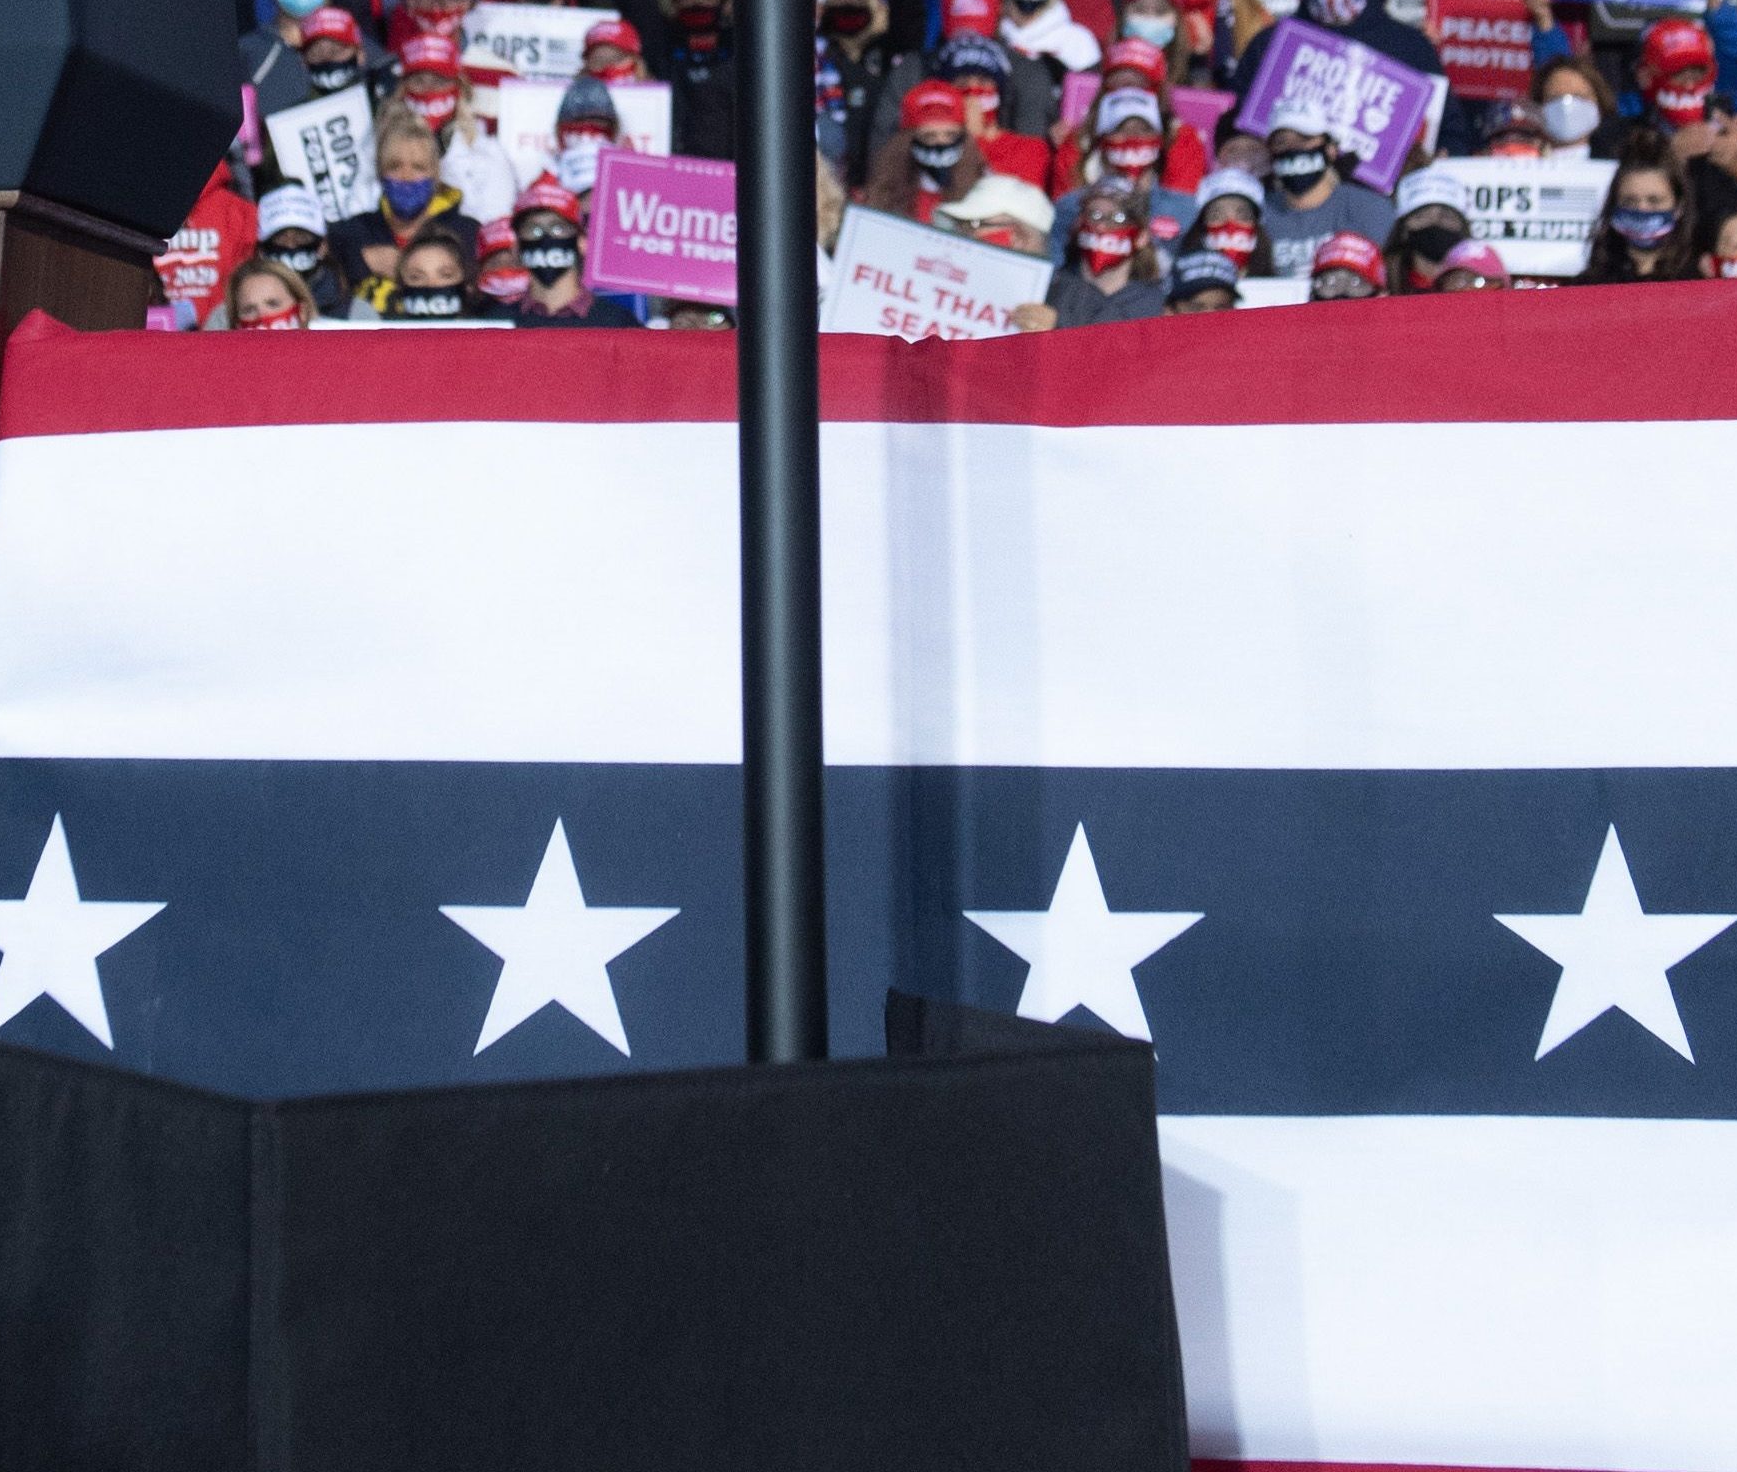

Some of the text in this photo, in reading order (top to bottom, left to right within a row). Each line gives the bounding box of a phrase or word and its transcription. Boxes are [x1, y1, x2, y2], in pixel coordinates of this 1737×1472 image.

[1475, 185, 1531, 212] OPS
[629, 234, 675, 256] FOR
[851, 264, 1016, 330] FILL THAT
[880, 306, 967, 338] SEAT
